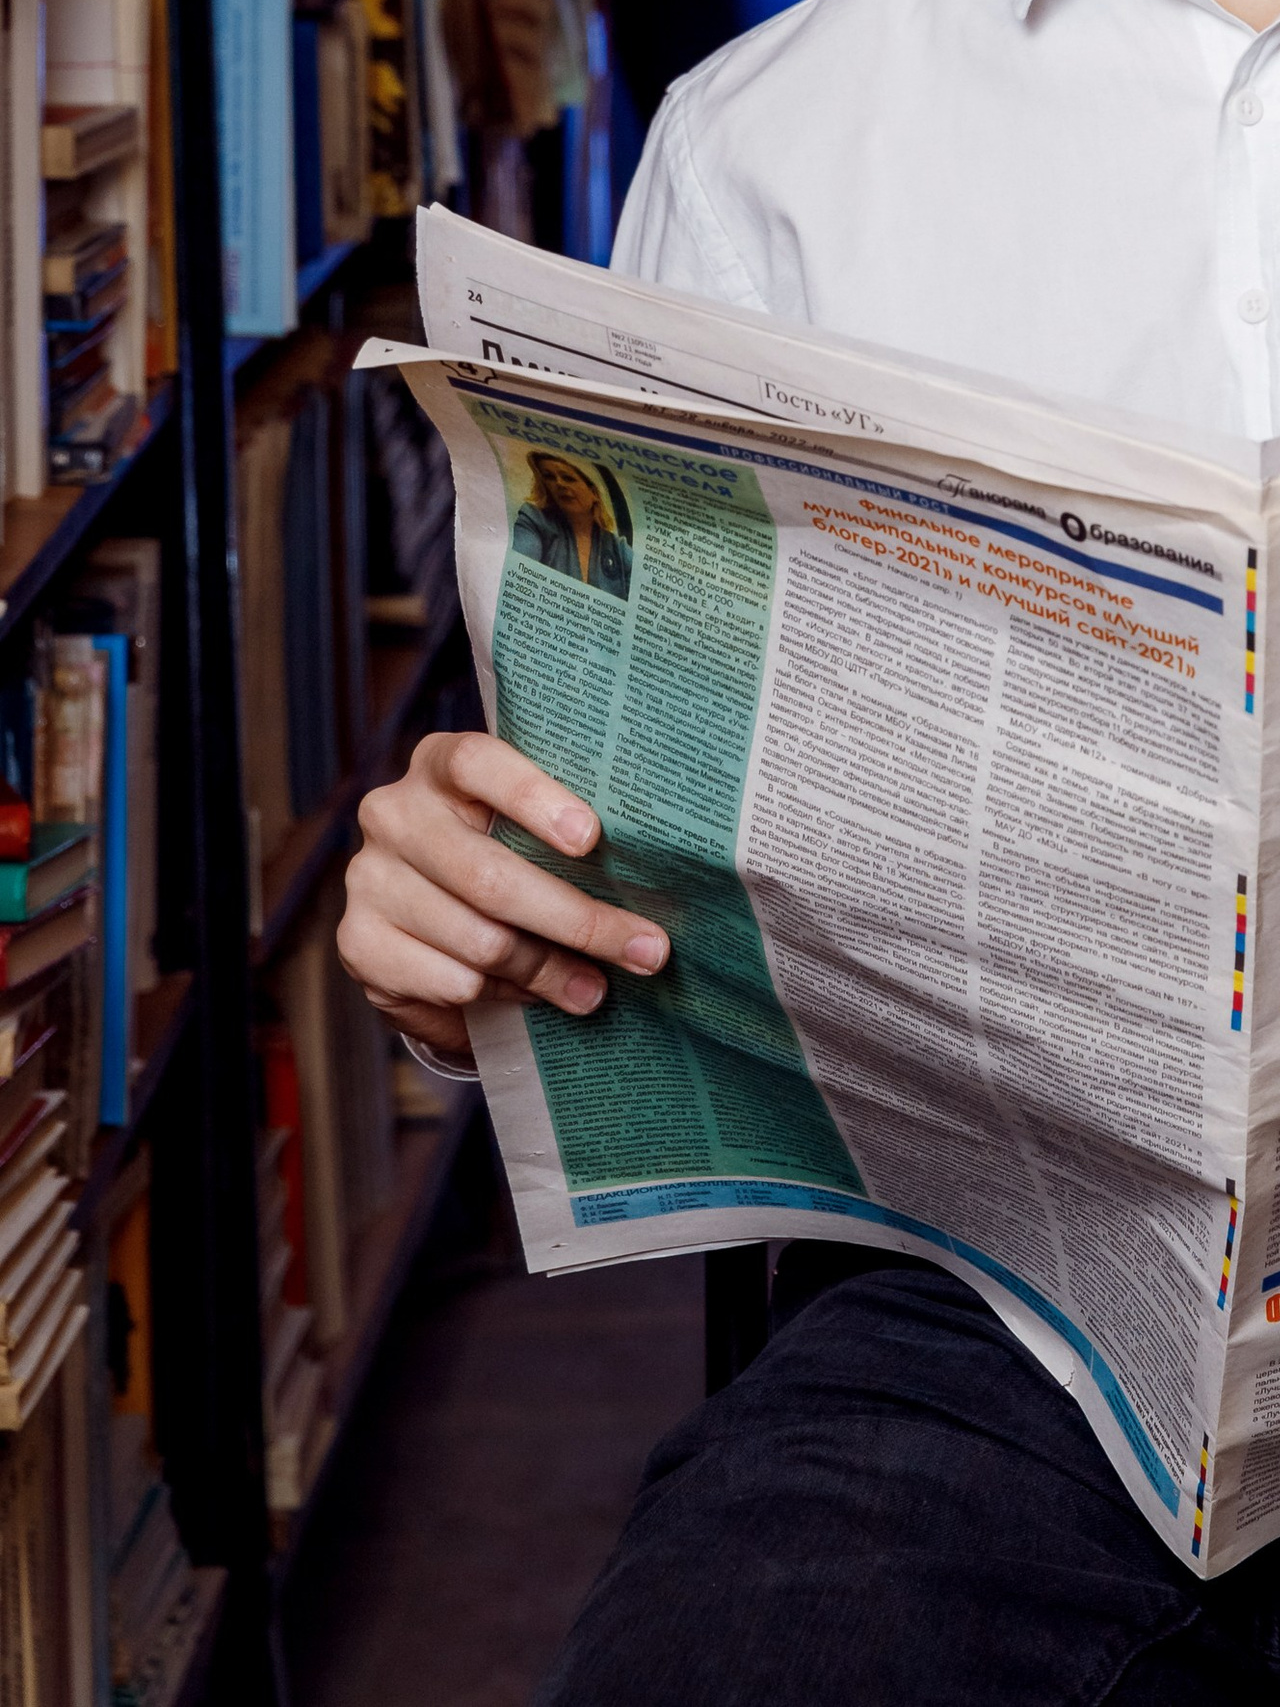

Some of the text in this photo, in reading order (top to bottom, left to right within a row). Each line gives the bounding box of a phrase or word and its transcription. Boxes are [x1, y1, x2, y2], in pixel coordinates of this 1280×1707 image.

[466, 289, 483, 305] 24
[478, 401, 737, 482] Педагогическое
[764, 381, 884, 433] Гость «УГ»
[504, 425, 732, 498] кредо учителя
[720, 445, 951, 514] ПРОФЕССИОНАЛЬНЫЙ РОСТ
[858, 499, 1133, 609] Финальное мероприятие
[937, 473, 1216, 577] Панорама Образования
[507, 569, 623, 625] «Учитель года города Краснода-
[518, 562, 625, 617] Прошли испытания конкурса
[799, 548, 998, 634] Номинация «Блог педагога дополнительного
[803, 501, 1198, 654] муниципальных конкурсов «Лучший
[812, 517, 1195, 678] блогер-2021» и «Лучший сайт-2021»
[779, 633, 803, 648] вания
[802, 642, 829, 659] МБОУ
[828, 652, 843, 666] ДО
[904, 686, 938, 708] Ушакова
[629, 727, 740, 783] Елена Алексеевна награждена
[1009, 717, 1038, 734] МАОУ
[1041, 731, 1075, 749] «Лицей
[1120, 763, 1171, 787] номинация
[578, 1179, 758, 1203] РЕДАКЦИОННАЯ КОЛЛЕГИЯ
